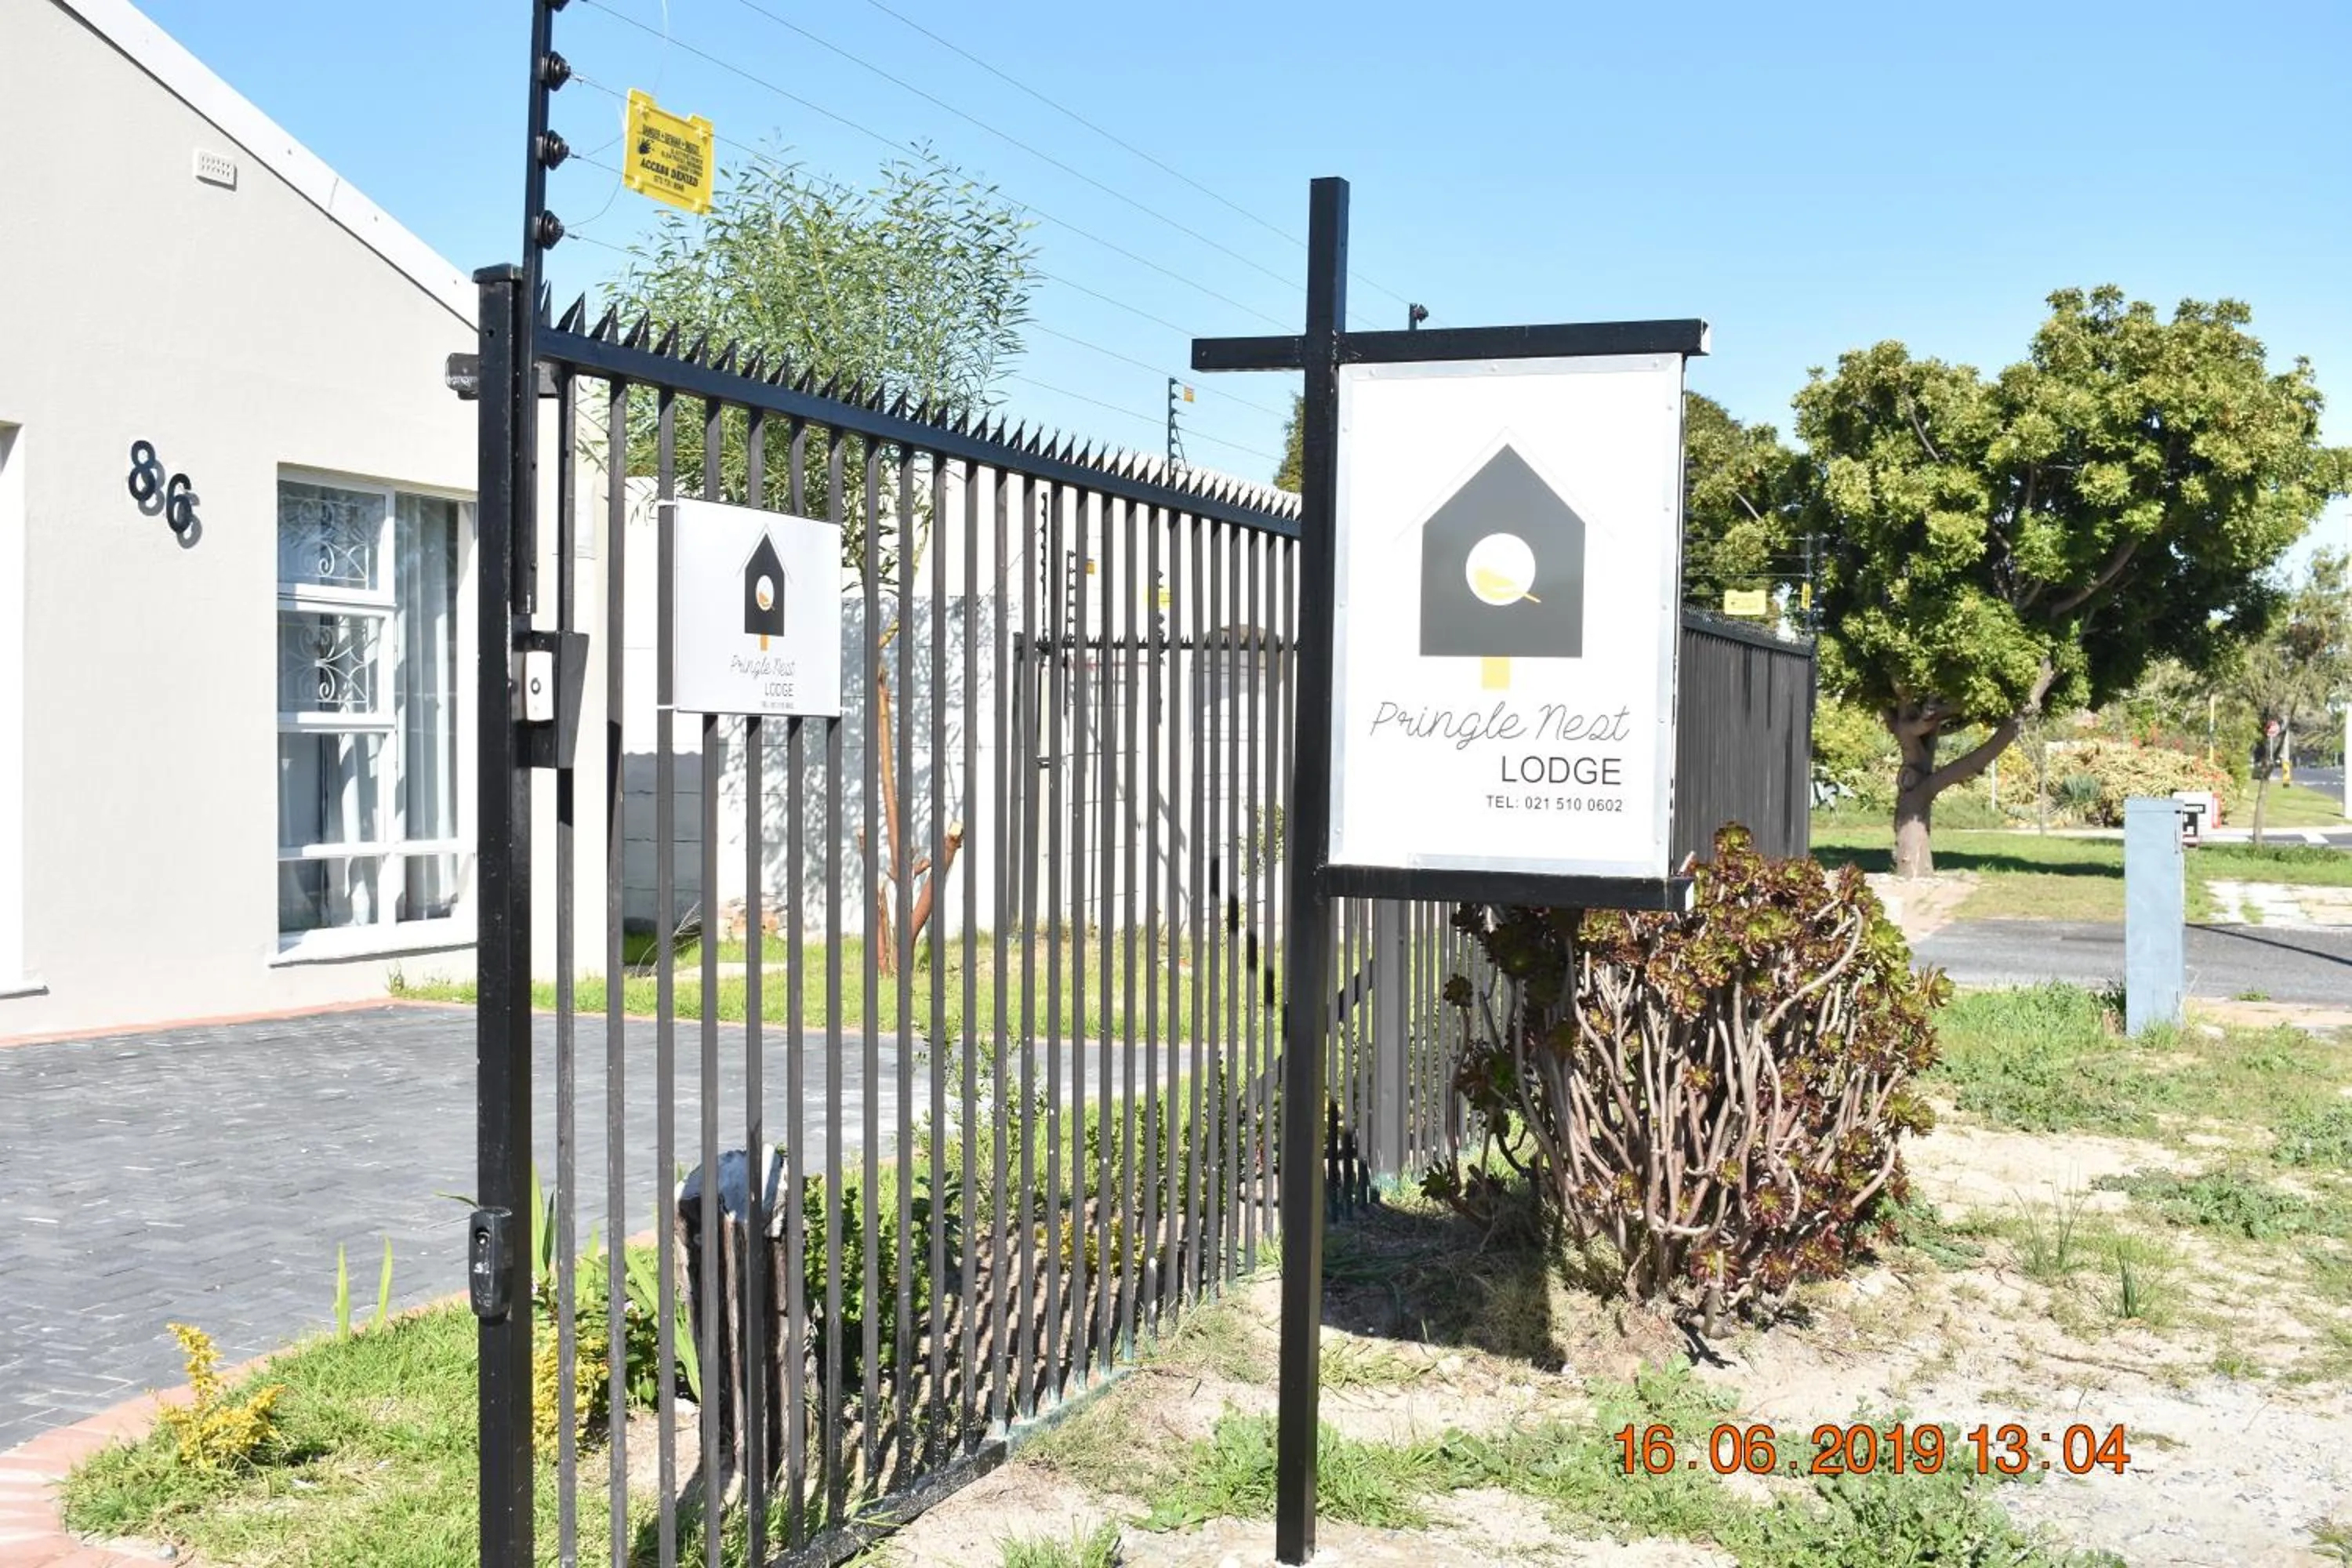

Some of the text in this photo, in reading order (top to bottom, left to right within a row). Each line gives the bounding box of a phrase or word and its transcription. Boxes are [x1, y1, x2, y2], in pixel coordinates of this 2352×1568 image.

[640, 158, 669, 176] ACCESS
[670, 167, 699, 187] DENIED
[129, 440, 192, 533] 86
[764, 682, 795, 697] LODGE
[1370, 701, 1631, 750] Pringle Nest
[1501, 755, 1622, 785] LODGE
[1486, 794, 1623, 812] TEL: 021 510 0602
